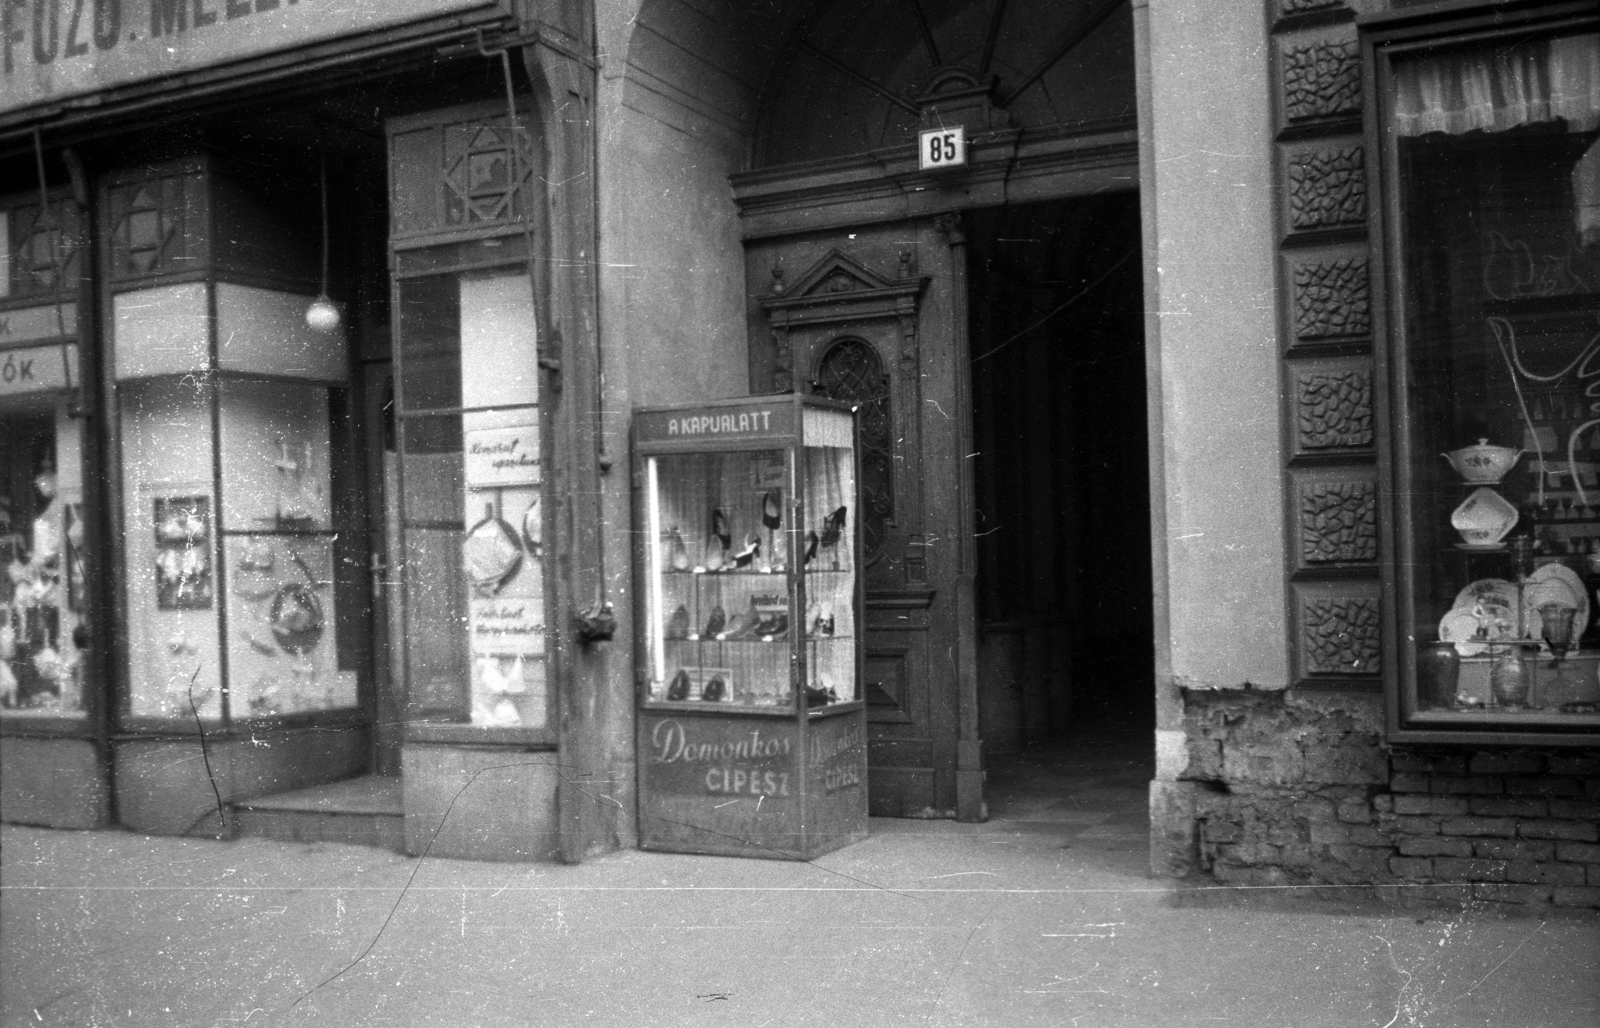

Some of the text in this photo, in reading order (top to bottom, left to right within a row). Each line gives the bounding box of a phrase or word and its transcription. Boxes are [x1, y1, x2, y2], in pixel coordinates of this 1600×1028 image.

[930, 134, 956, 163] 85
[668, 418, 679, 435] A
[652, 718, 790, 764] Domonkos
